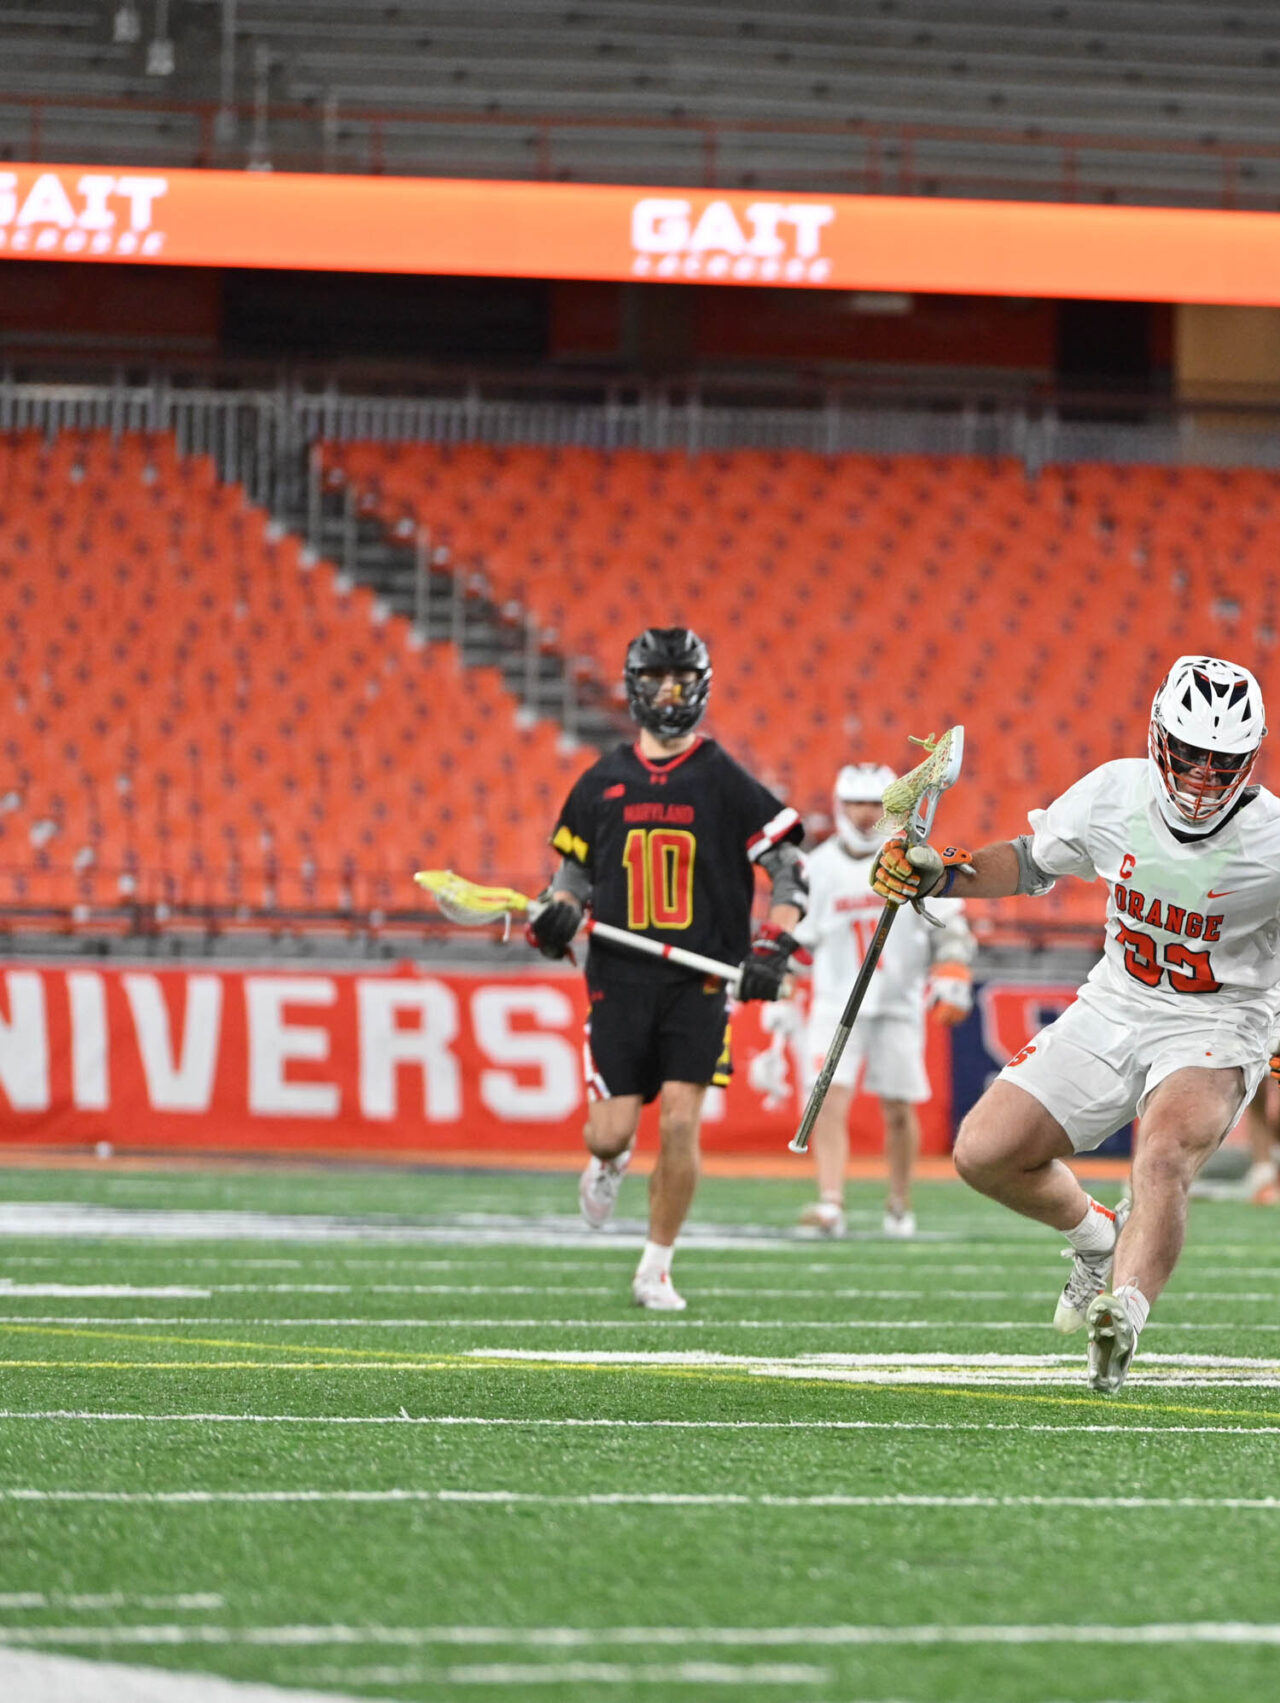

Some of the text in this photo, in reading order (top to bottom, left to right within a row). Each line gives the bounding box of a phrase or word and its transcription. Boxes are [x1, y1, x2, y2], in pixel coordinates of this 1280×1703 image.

[631, 198, 835, 258] GAIT
[622, 828, 697, 931] 10
[1119, 853, 1137, 880] C
[1114, 883, 1225, 942] ORANGE
[0, 970, 728, 1122] NIVERS
